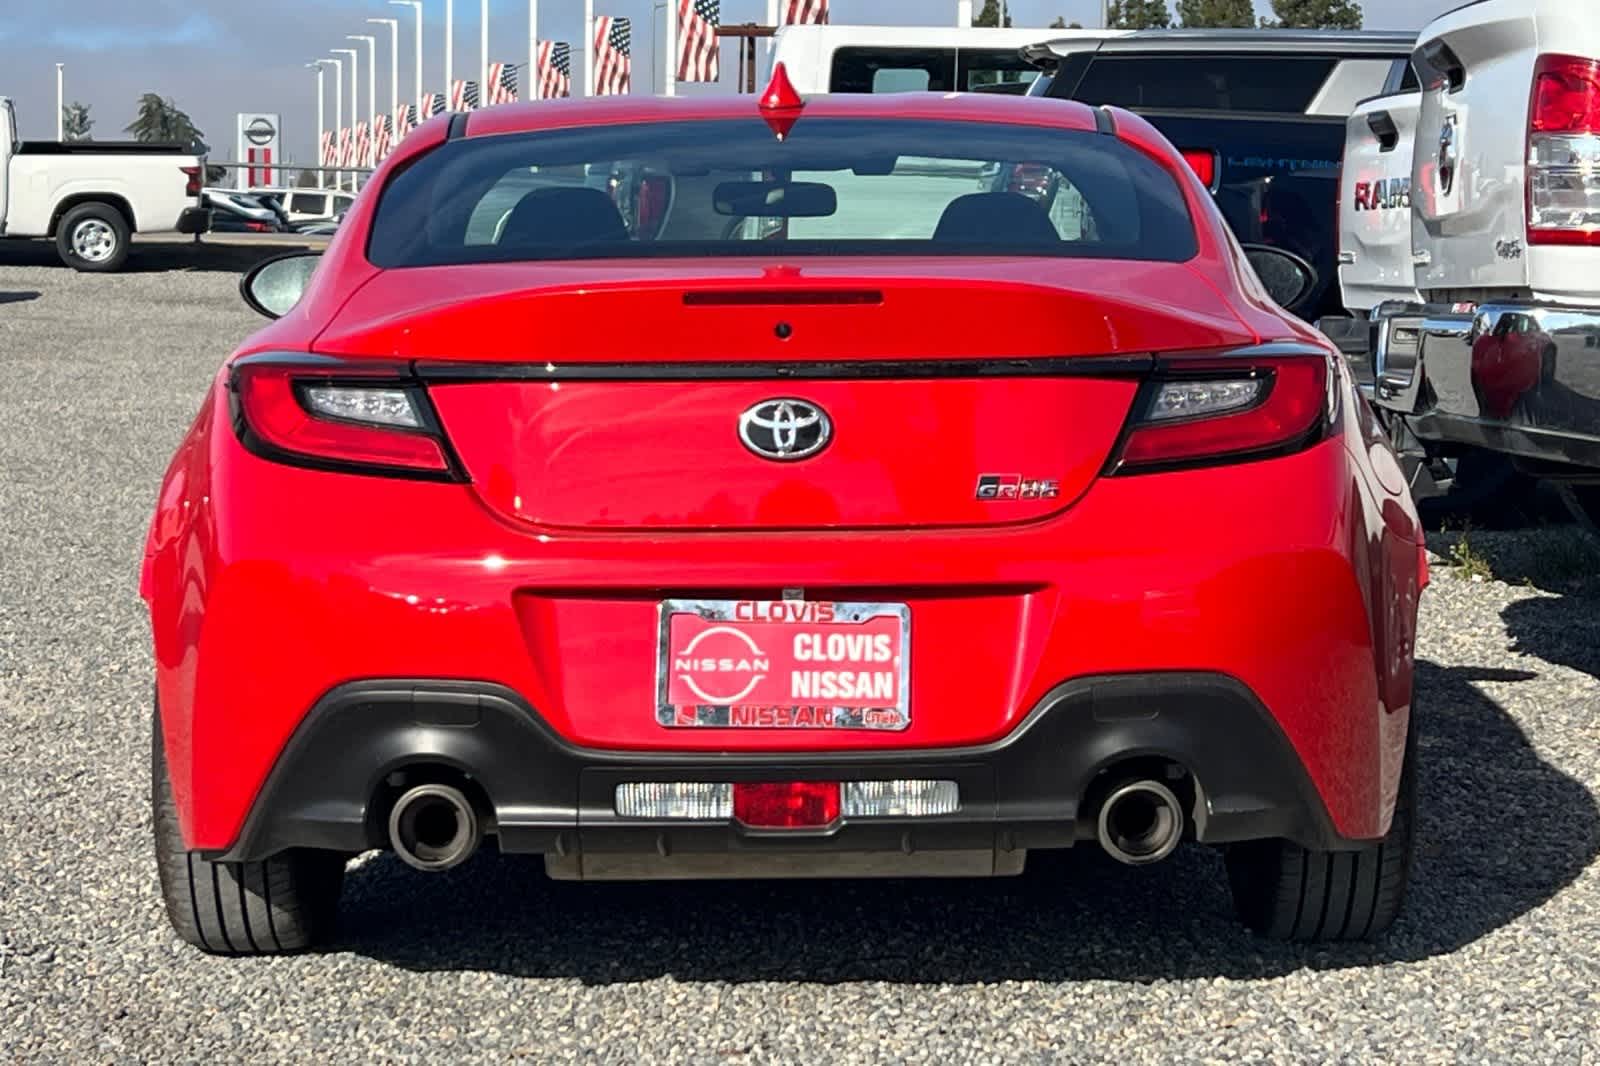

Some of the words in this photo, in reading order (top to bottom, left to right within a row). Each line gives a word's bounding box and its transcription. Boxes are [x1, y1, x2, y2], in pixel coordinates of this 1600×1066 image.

[1354, 177, 1412, 211] RAM
[734, 600, 835, 622] CLOVIS
[793, 633, 892, 662] CLOVIS
[674, 658, 769, 672] NISSAN
[791, 671, 893, 699] NISSAN
[730, 705, 834, 726] NISSAN
